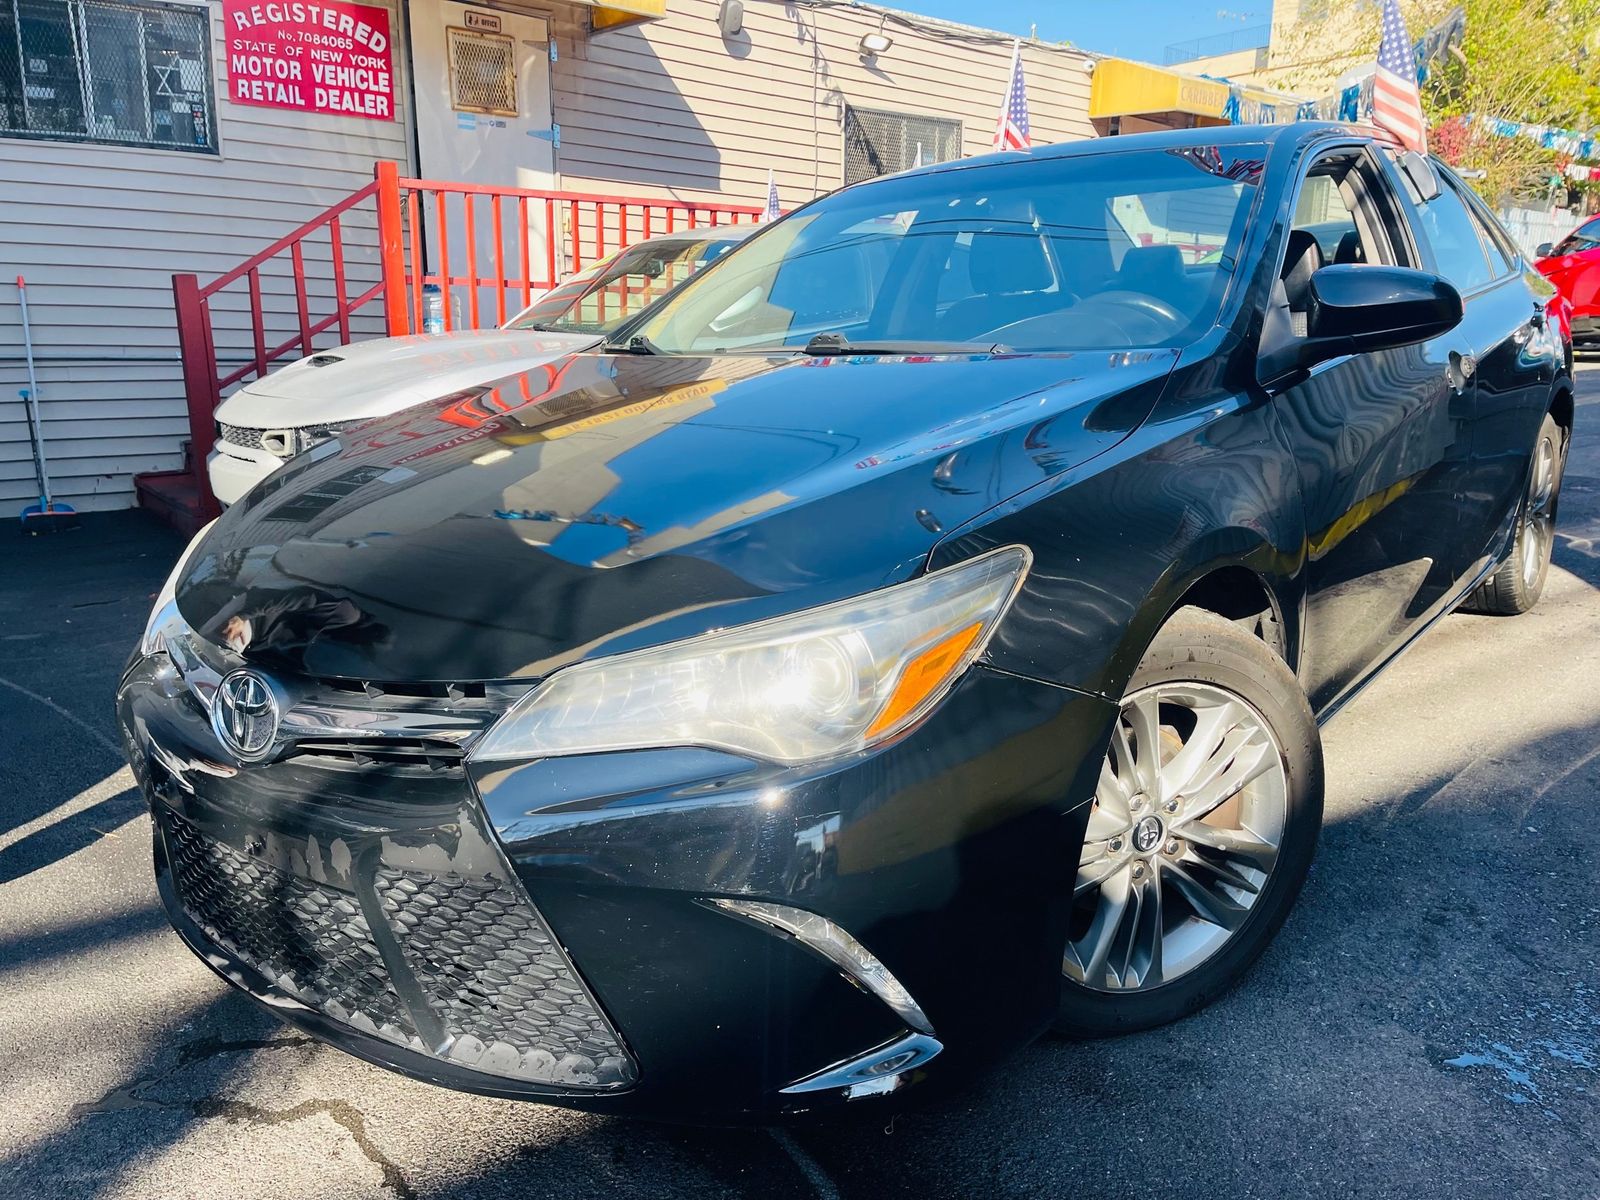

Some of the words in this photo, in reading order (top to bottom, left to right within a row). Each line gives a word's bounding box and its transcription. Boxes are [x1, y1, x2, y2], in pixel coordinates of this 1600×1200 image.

[233, 3, 386, 53] REGISTERED
[481, 18, 498, 28] OFFICE
[232, 54, 302, 80] MOTOR
[311, 62, 390, 93] VEHICLE
[233, 39, 276, 54] STATE
[285, 46, 303, 57] OF
[311, 48, 343, 63] NEW
[349, 53, 386, 70] YORK
[237, 78, 305, 106] RETAIL
[315, 87, 389, 116] DEALER
